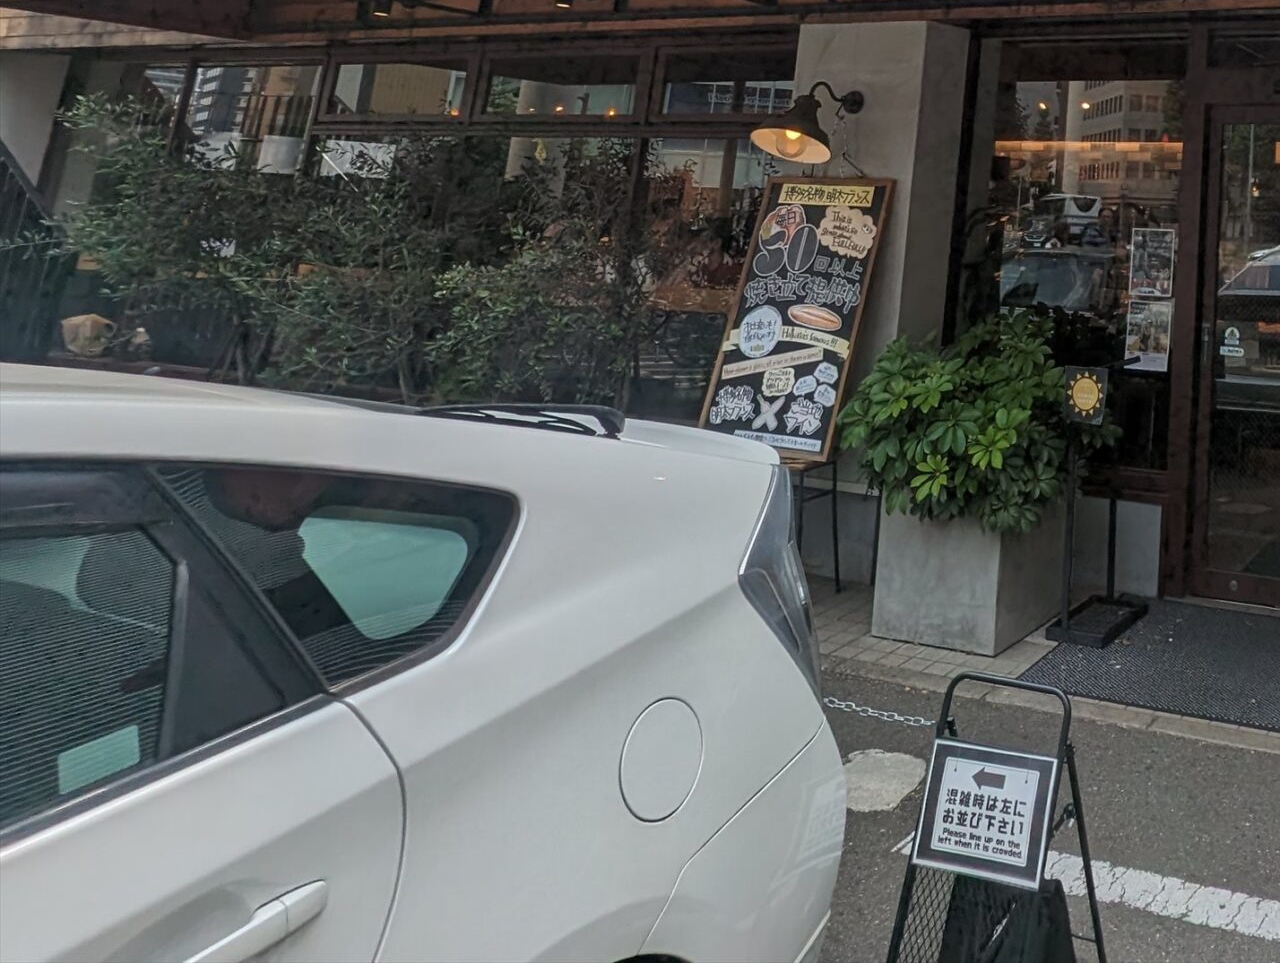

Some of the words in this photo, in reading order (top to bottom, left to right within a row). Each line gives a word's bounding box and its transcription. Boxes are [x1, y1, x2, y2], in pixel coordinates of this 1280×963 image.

[814, 256, 864, 281] 回以上
[945, 788, 1027, 818] 混雑時は左に
[942, 808, 1024, 836] お並び下さい
[938, 836, 951, 845] left
[954, 839, 972, 849] when
[974, 843, 980, 851] it
[983, 844, 989, 852] is
[943, 827, 966, 839] Please
[969, 832, 982, 842] line
[984, 835, 993, 845] up
[1008, 840, 1020, 849] the
